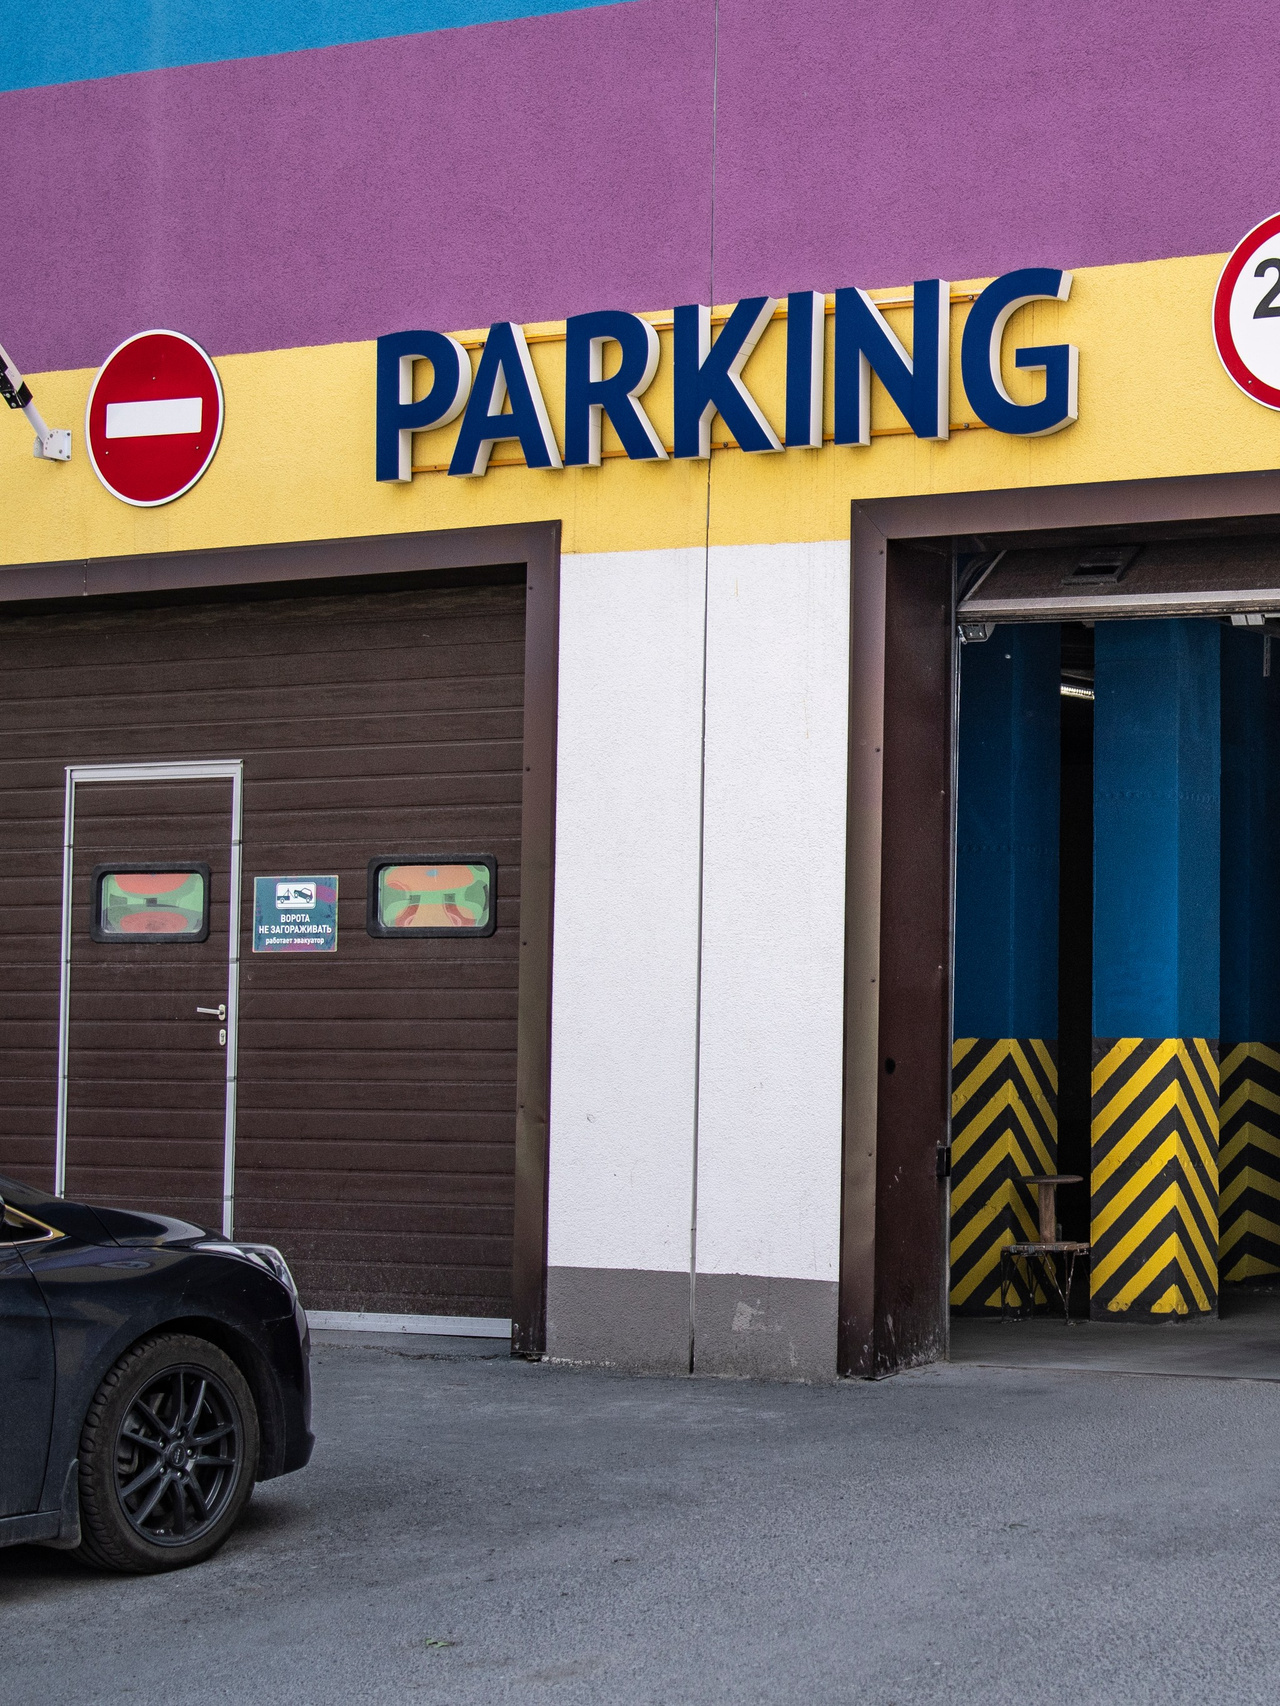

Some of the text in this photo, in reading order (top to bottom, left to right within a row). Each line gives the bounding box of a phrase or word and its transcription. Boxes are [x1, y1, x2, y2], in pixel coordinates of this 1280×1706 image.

[376, 267, 1079, 484] PARKING
[280, 913, 311, 923] ВОРОТА
[258, 924, 332, 934] НЕ ЗАГОРАЖИВАТЬ
[265, 936, 325, 946] работает эвакуатор
